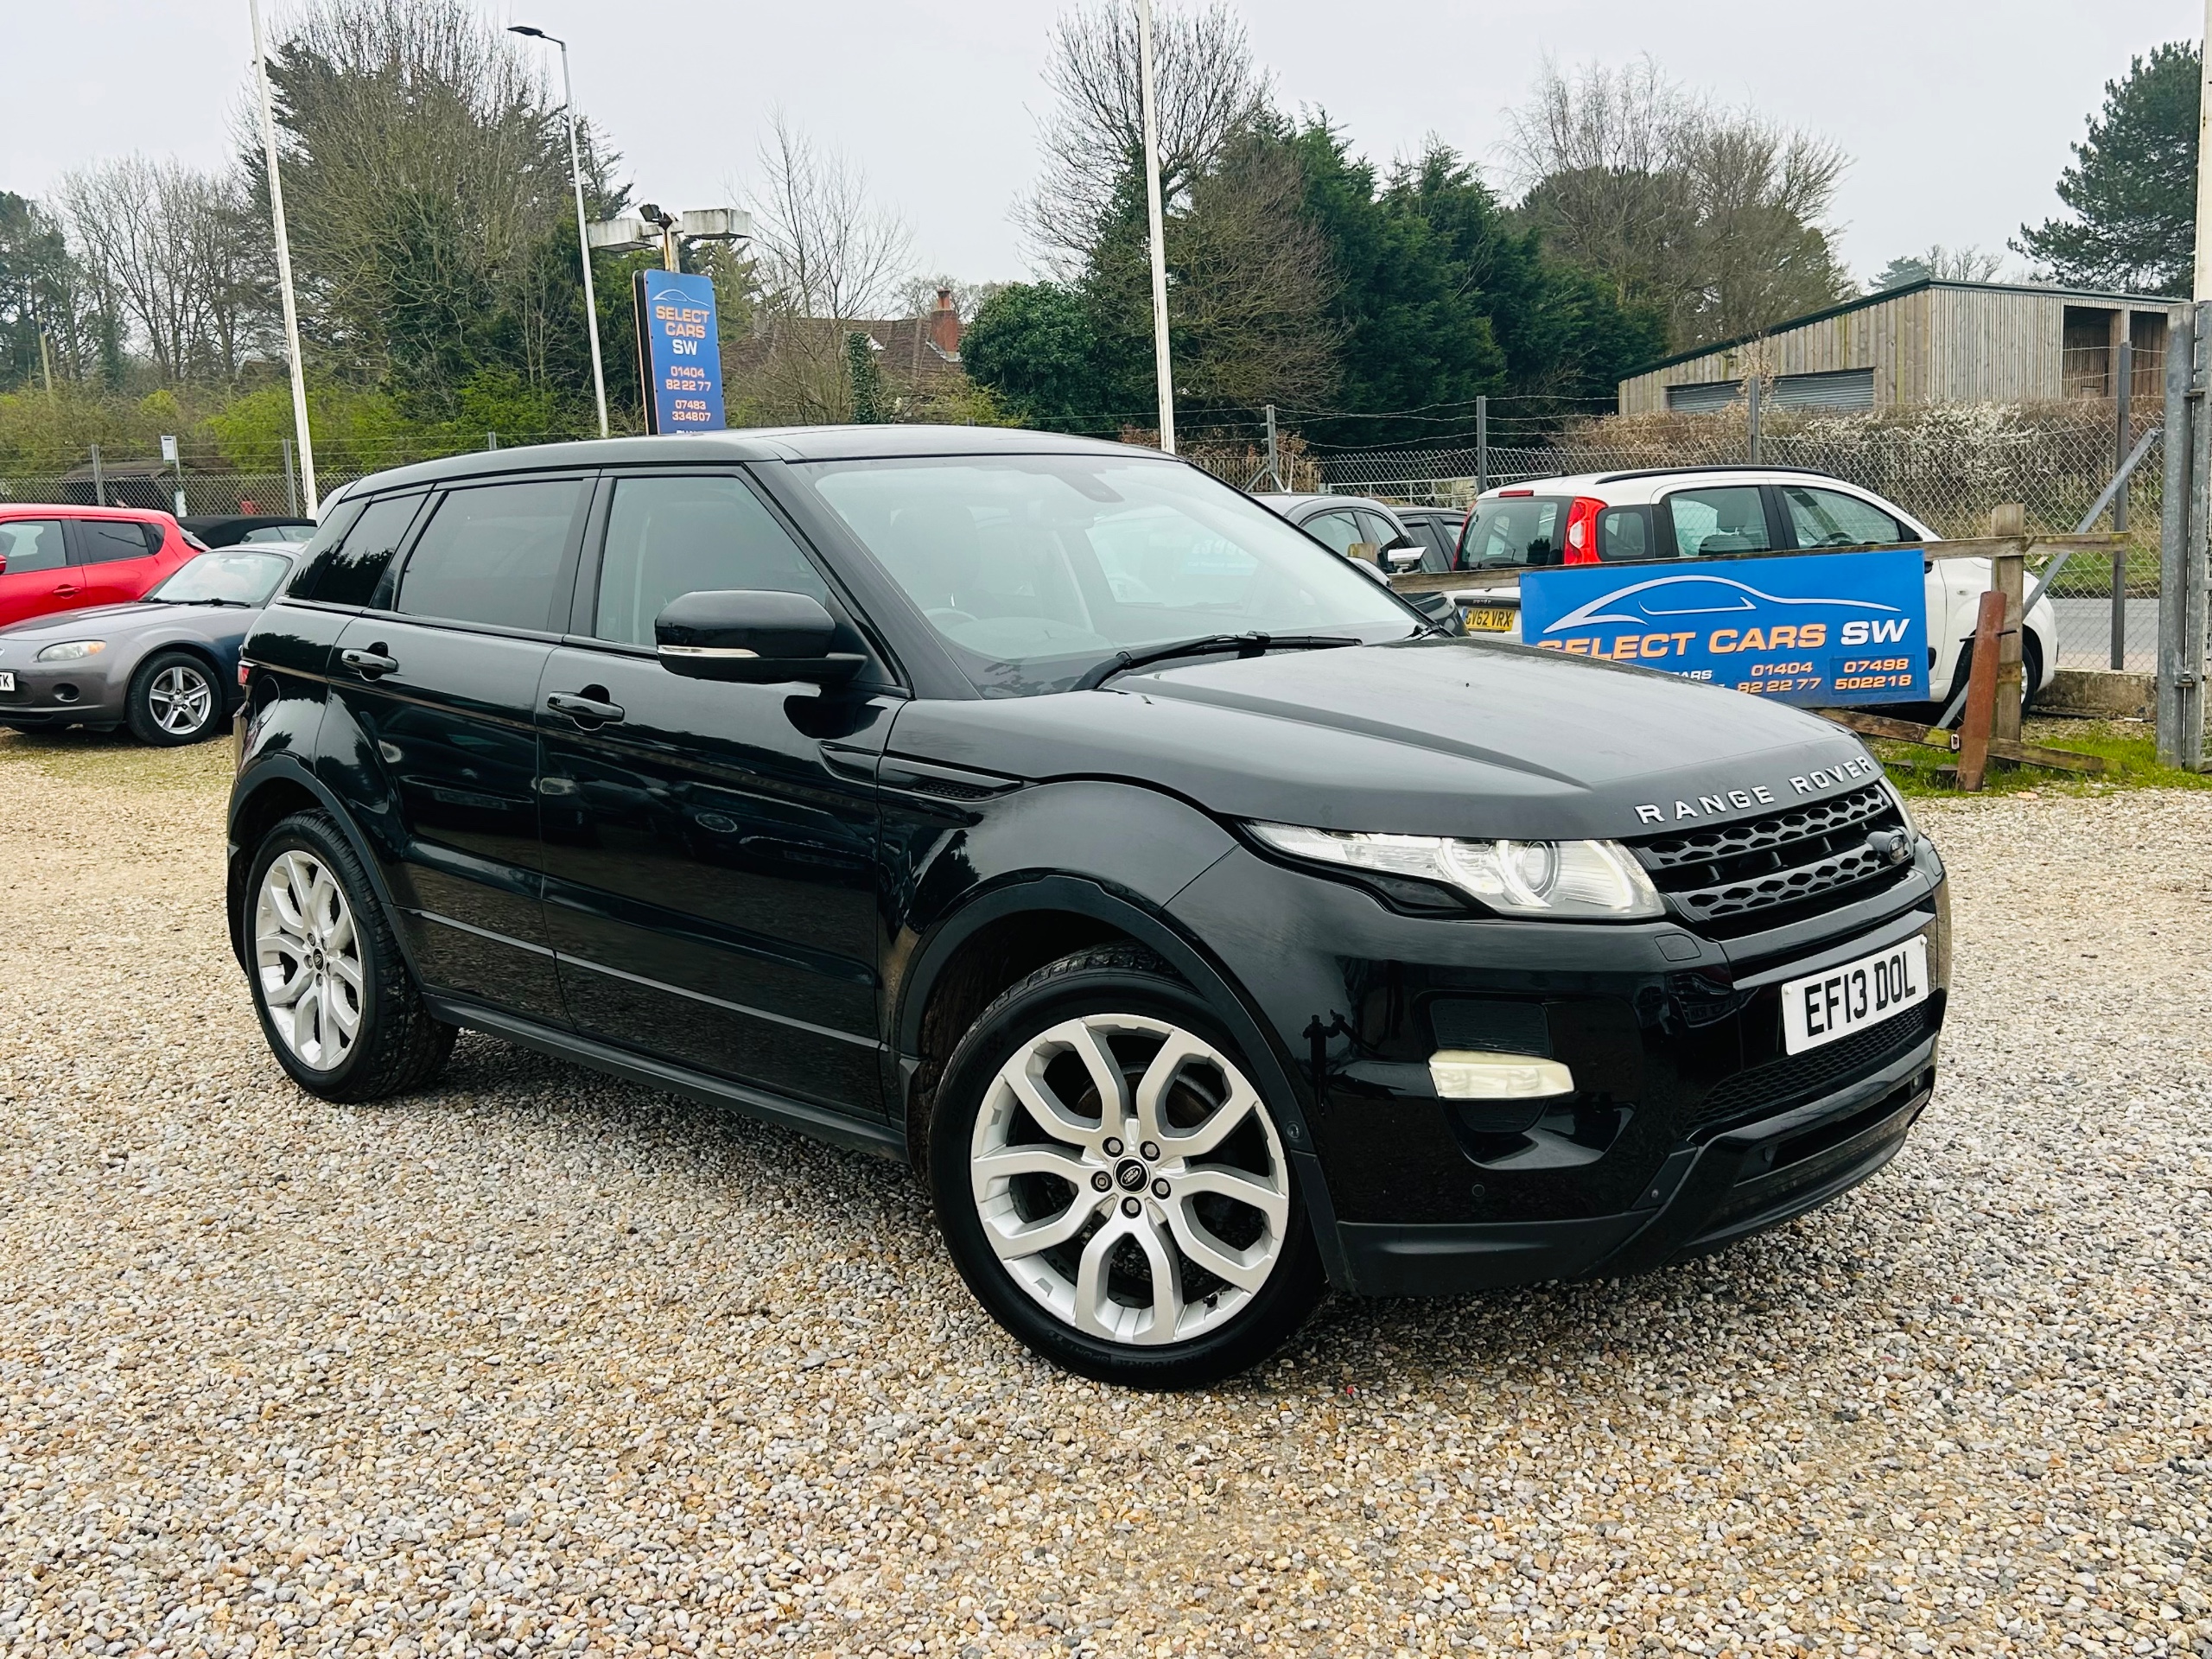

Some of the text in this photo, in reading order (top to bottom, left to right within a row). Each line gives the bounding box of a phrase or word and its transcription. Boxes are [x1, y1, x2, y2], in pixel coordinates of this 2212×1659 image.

[656, 305, 710, 324] SELECT
[665, 321, 706, 339] CARS
[672, 339, 697, 356] SW
[671, 365, 705, 378] 01404
[675, 399, 707, 410] 07483
[671, 410, 711, 423] 334807
[1465, 610, 1511, 627] GV62 VRX
[1708, 623, 1827, 654] CARS
[1840, 618, 1910, 645] SW
[1751, 661, 1814, 677] 01404
[1843, 658, 1909, 674] 07498
[1834, 674, 1913, 690] 502218
[1634, 756, 1873, 824] RANGE ROVER
[1804, 950, 1916, 1038] EF13 DOL
